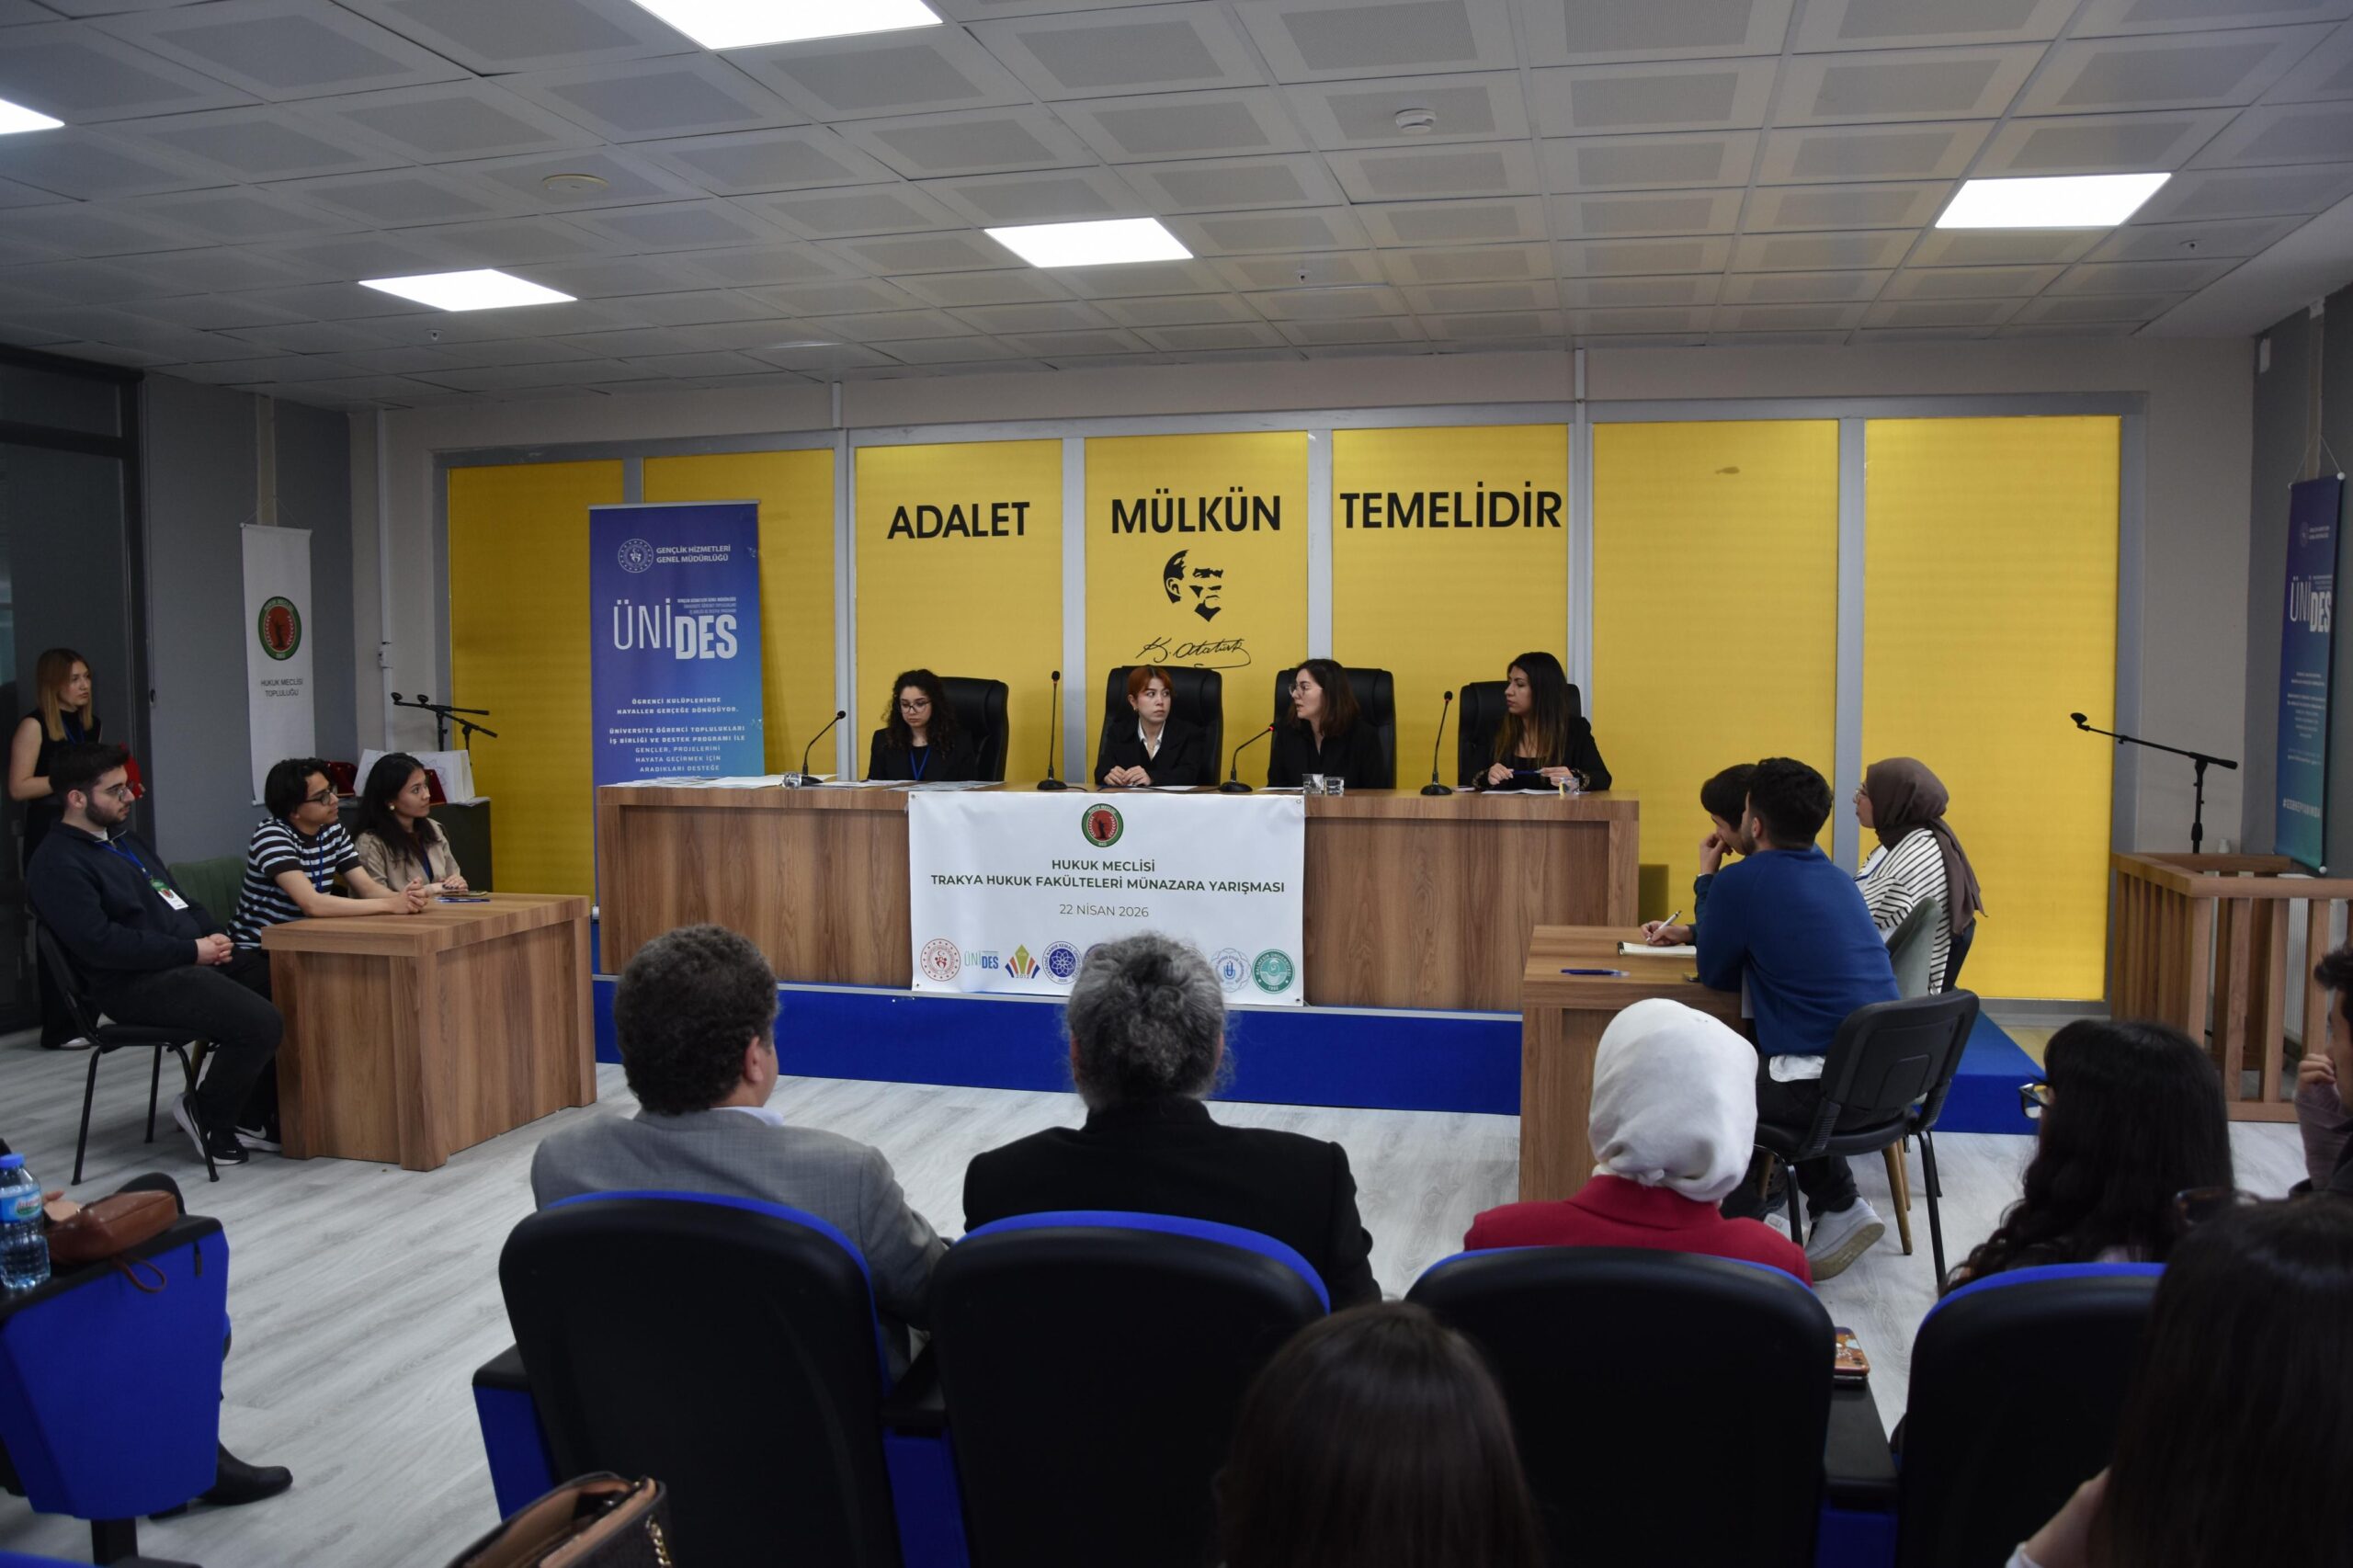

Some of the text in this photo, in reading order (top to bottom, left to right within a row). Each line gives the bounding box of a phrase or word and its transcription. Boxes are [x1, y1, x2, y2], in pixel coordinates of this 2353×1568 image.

[888, 482, 1563, 539] ADALET MÜLKÜN TEMELİDİR
[656, 544, 731, 555] GENÇLİK HİZMETLERİ
[681, 553, 729, 562] MÜDÜRLÜĞÜ
[1052, 859, 1155, 872] HUKUK MECLİSİ
[931, 875, 1284, 894] TRAKYA HUKUK FAKÜLTELERİ MÜNAZARA YARIŞMASI
[1059, 903, 1149, 917] 22 NİSAN 2026
